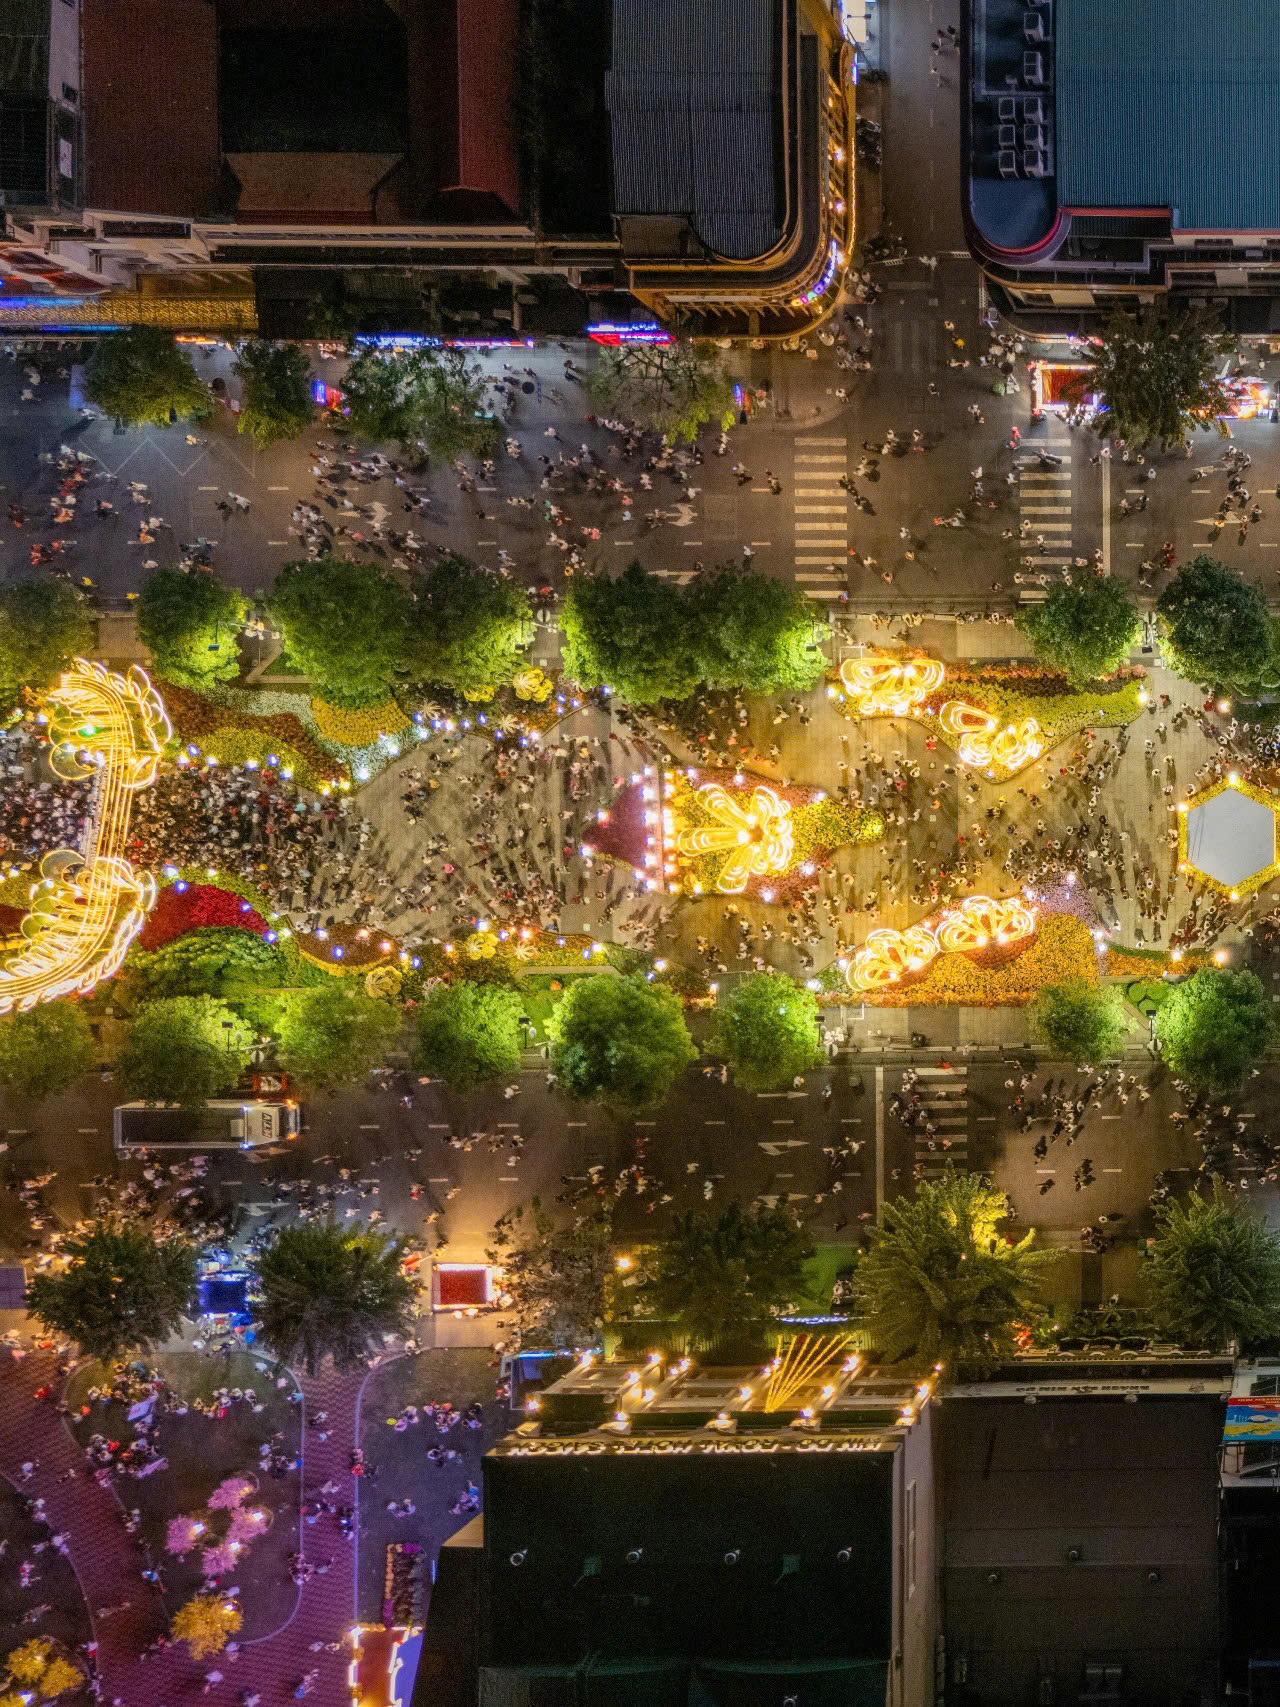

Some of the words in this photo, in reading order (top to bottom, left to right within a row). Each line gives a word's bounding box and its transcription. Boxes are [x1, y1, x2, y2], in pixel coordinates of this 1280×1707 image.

[505, 1441, 607, 1456] SAIGON
[612, 1440, 694, 1455] HOTEL
[699, 1439, 779, 1454] ROYAL
